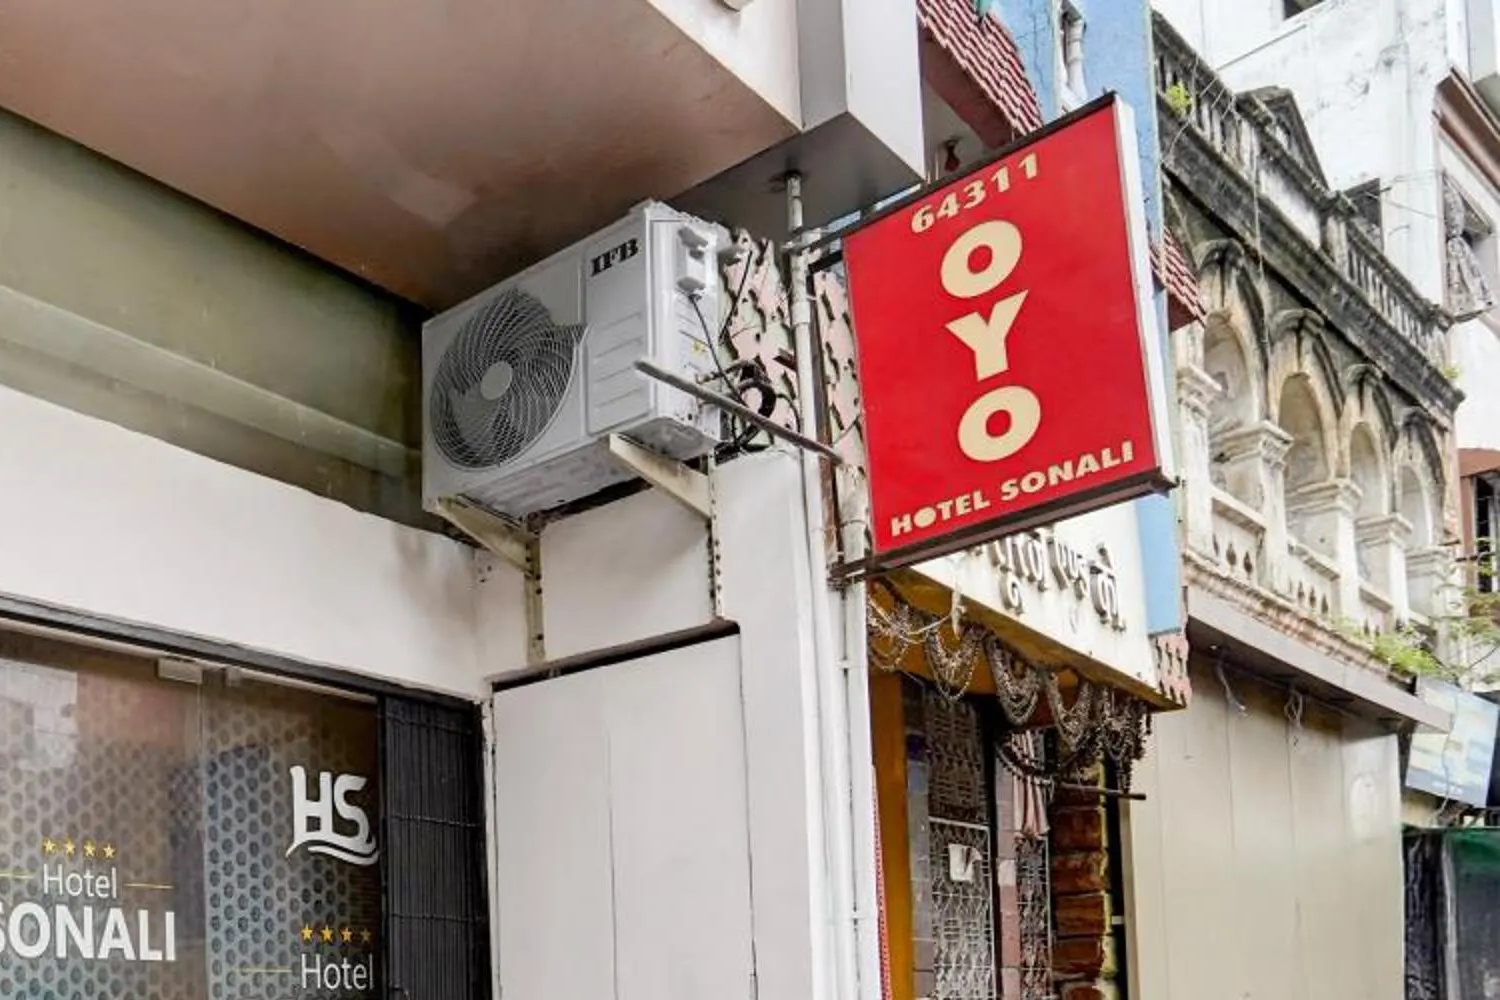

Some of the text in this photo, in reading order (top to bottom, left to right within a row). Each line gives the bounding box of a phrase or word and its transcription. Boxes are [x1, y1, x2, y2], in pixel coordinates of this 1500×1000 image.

[911, 153, 1039, 233] 64311
[591, 237, 640, 277] IFB
[940, 219, 1042, 462] OYO
[890, 440, 1134, 537] HOTEL SONALI
[43, 863, 117, 898] Hotel
[301, 953, 374, 990] Hotel
